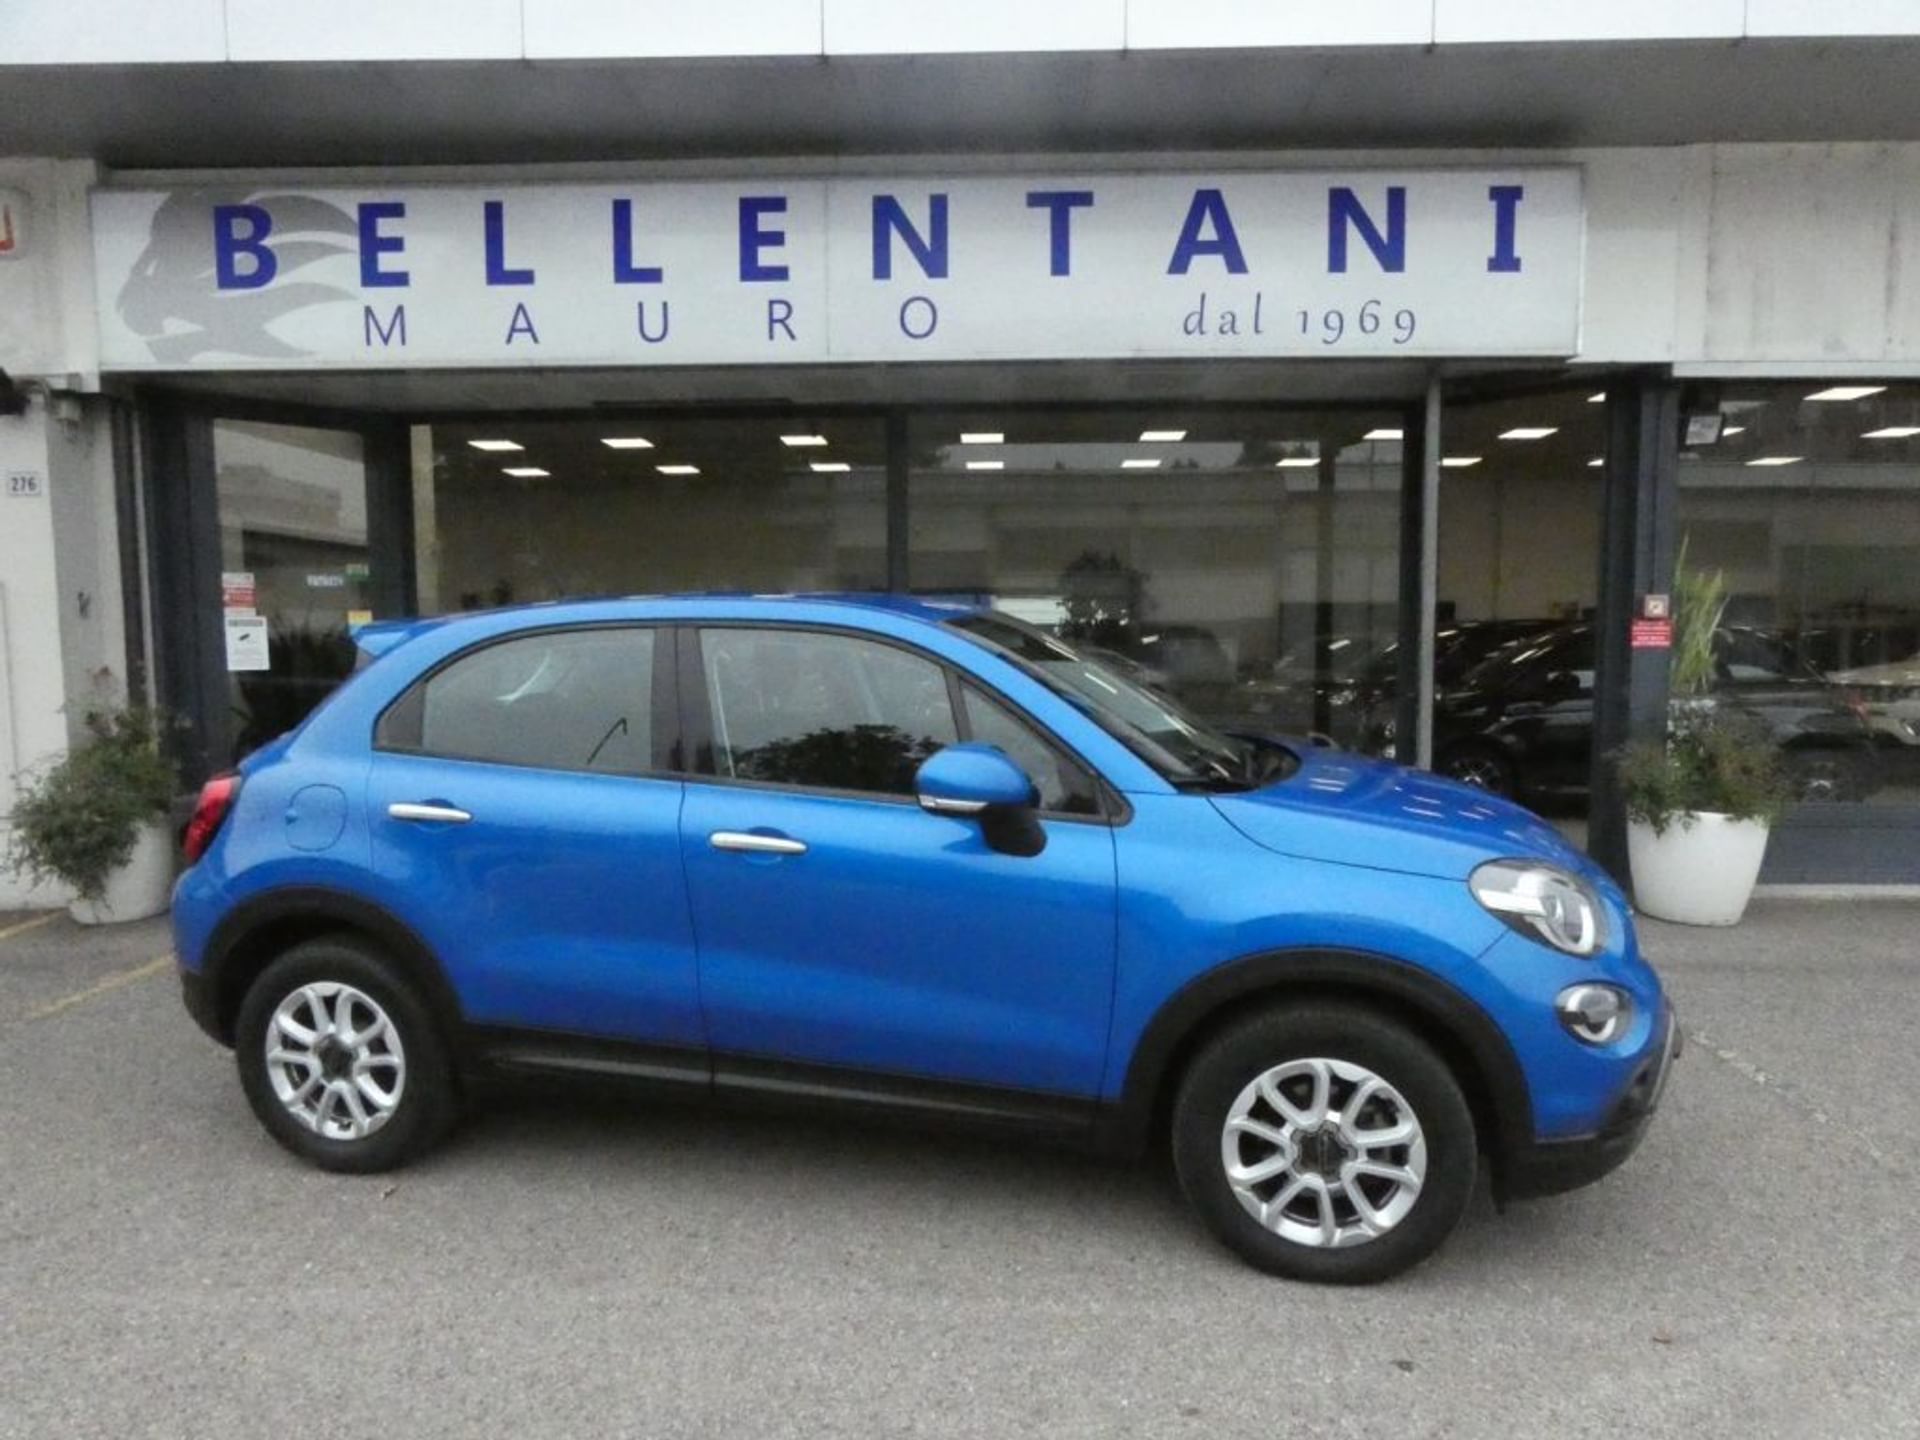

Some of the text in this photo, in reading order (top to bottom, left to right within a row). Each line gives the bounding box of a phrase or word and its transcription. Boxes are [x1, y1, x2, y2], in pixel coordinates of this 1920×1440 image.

[214, 186, 1524, 290] BELLENTANI
[366, 296, 938, 347] MAURO
[1184, 292, 1418, 345] dal 1969
